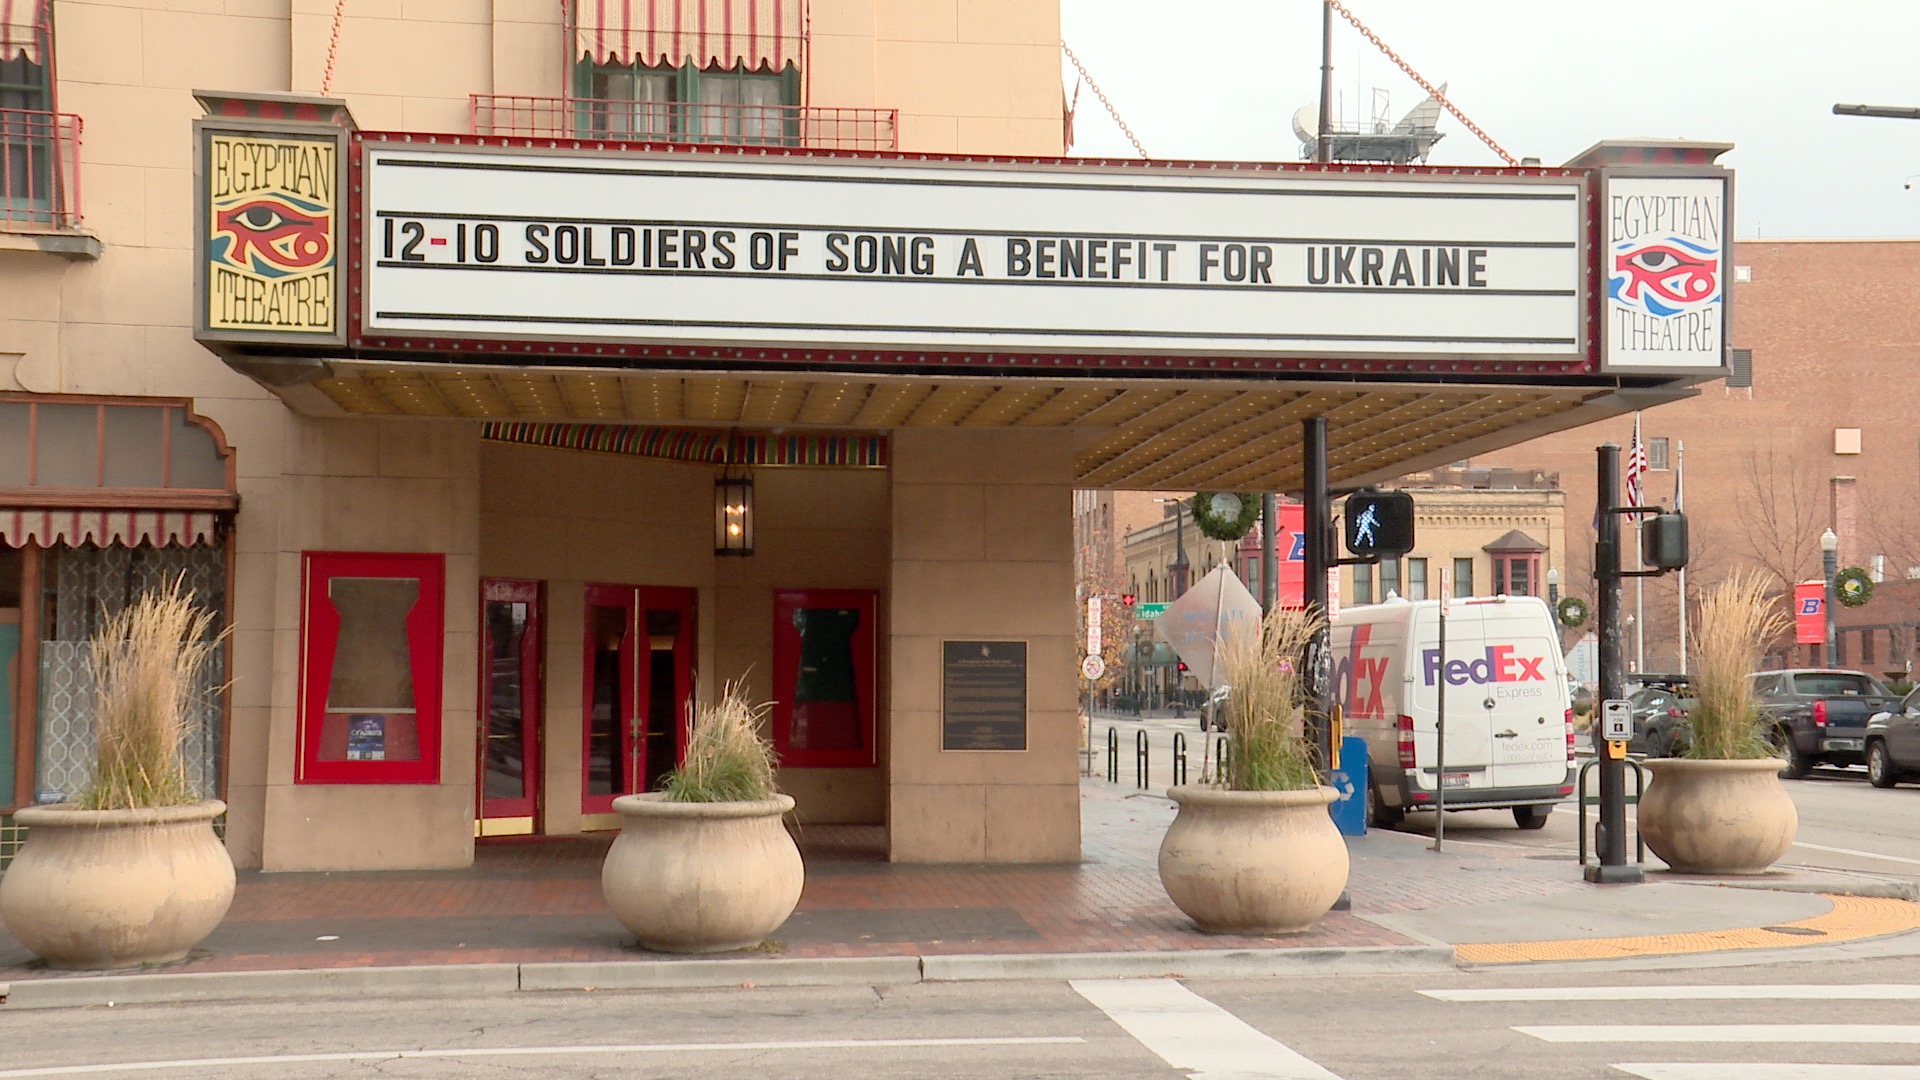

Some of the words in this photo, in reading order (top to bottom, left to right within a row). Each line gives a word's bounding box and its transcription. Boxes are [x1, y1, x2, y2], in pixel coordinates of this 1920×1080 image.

[214, 140, 333, 203] EGYPTIAN
[1610, 195, 1720, 245] EGYPTIAN
[384, 217, 500, 264] 12-10
[525, 223, 736, 270] SOLDIERS
[750, 231, 800, 272] OF
[826, 232, 935, 276] SONG
[956, 237, 985, 277] A
[1006, 237, 1177, 282] BENEFIT
[1199, 243, 1273, 284] FOR
[1307, 246, 1487, 288] UKRAINE
[217, 267, 330, 327] THEATRE
[1615, 307, 1714, 352] THEATRE
[1142, 609, 1163, 618] Idah
[1422, 645, 1546, 686] FedEx
[1496, 686, 1543, 699] Express
[1502, 740, 1553, 751] fedex.com
